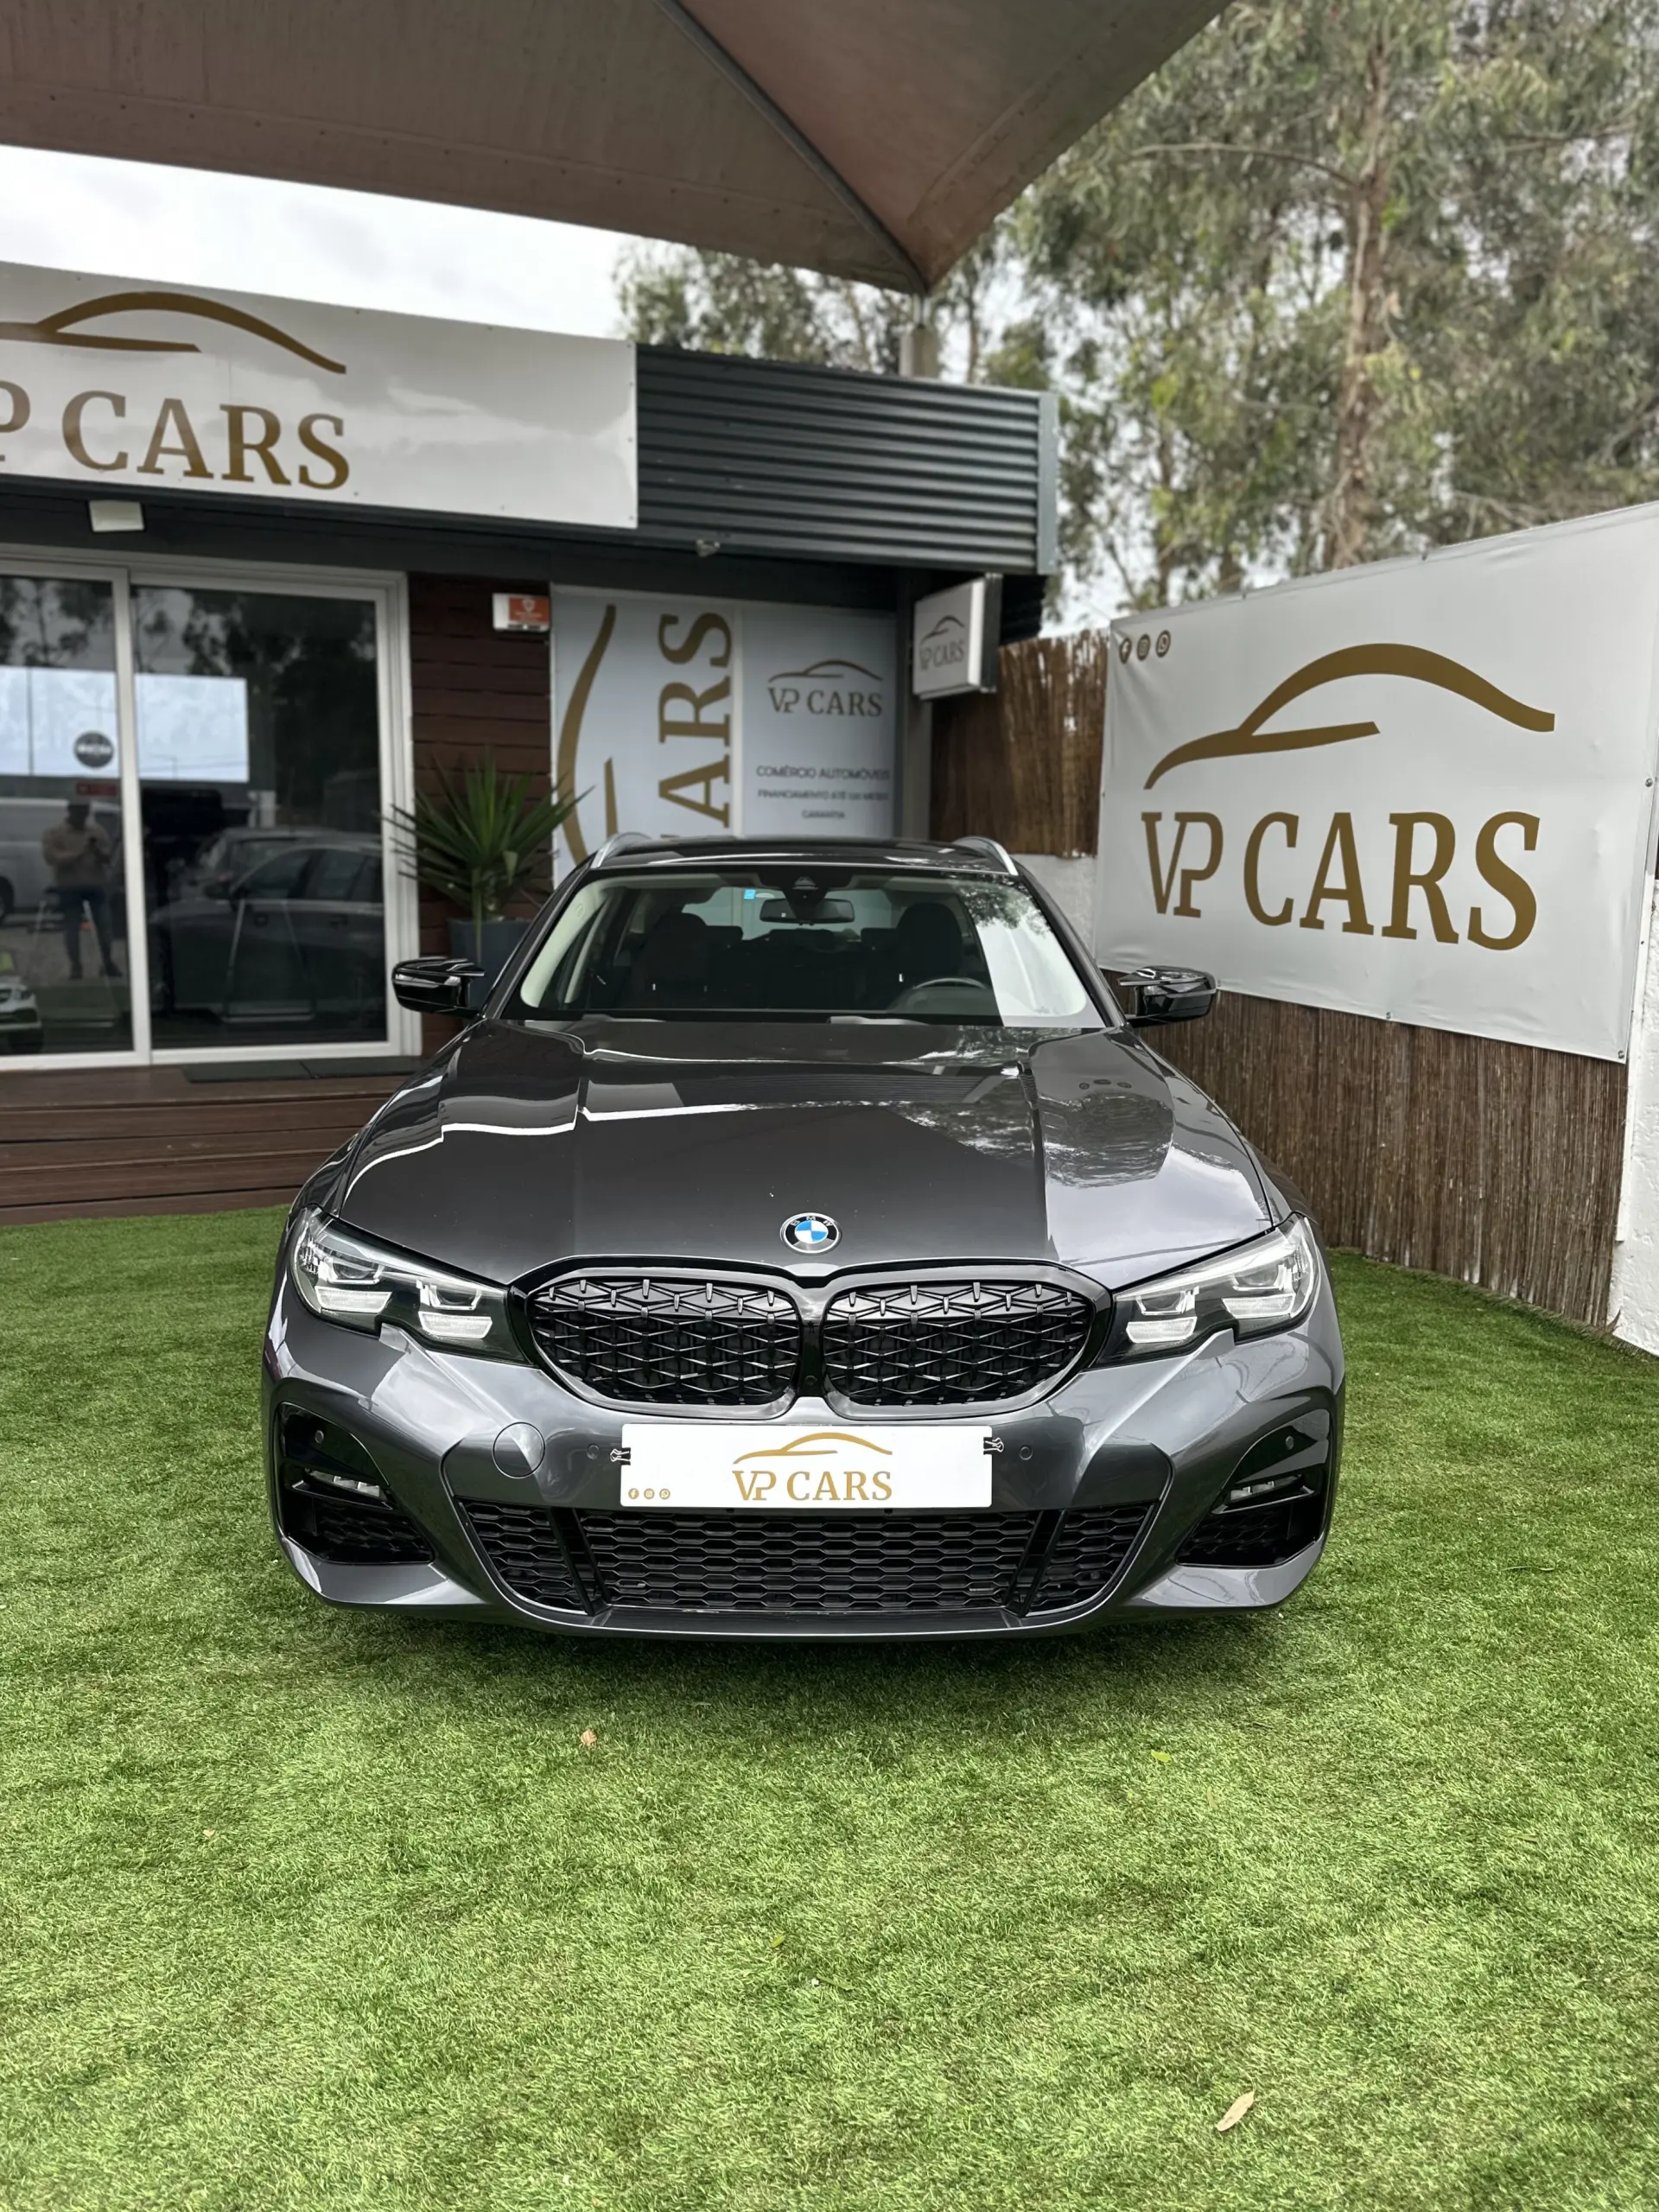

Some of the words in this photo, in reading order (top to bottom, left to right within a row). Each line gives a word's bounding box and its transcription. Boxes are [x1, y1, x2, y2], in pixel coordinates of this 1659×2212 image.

[61, 391, 350, 490] CARS
[766, 687, 800, 714] VP
[807, 690, 882, 717] CARS
[658, 612, 731, 838] ARS
[756, 765, 817, 779] COMÉRCIO
[1141, 811, 1224, 918] VP
[1243, 810, 1541, 950] CARS
[790, 1216, 833, 1226] BMW
[732, 1471, 777, 1501] VP
[786, 1471, 893, 1501] CARS
